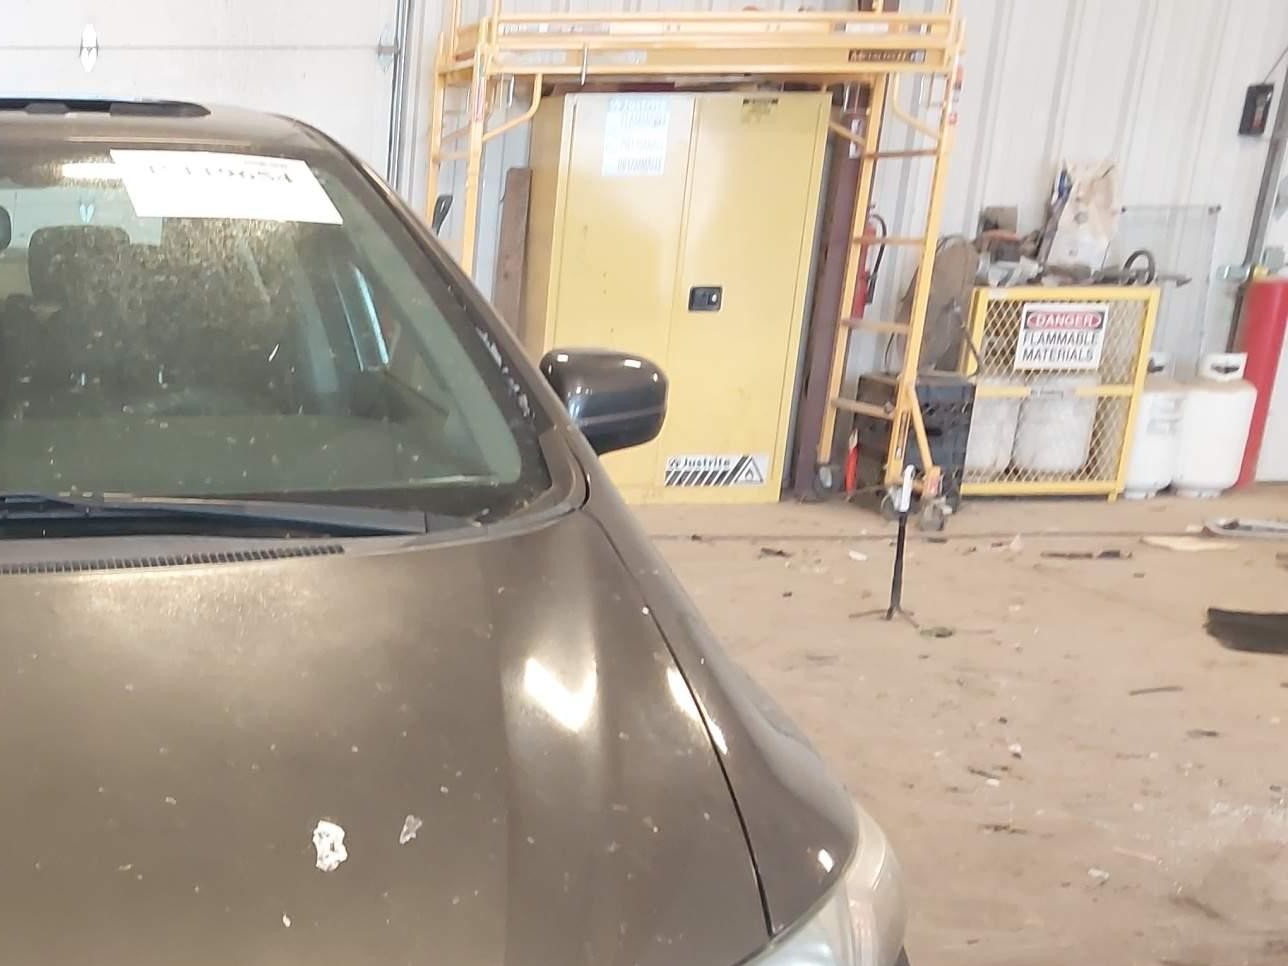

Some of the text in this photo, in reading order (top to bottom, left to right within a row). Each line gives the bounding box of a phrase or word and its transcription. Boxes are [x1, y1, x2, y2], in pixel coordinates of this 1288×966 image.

[1035, 312, 1094, 328] DANGER
[1023, 331, 1097, 345] FLAMMABLE
[1022, 348, 1094, 361] MATERIALS
